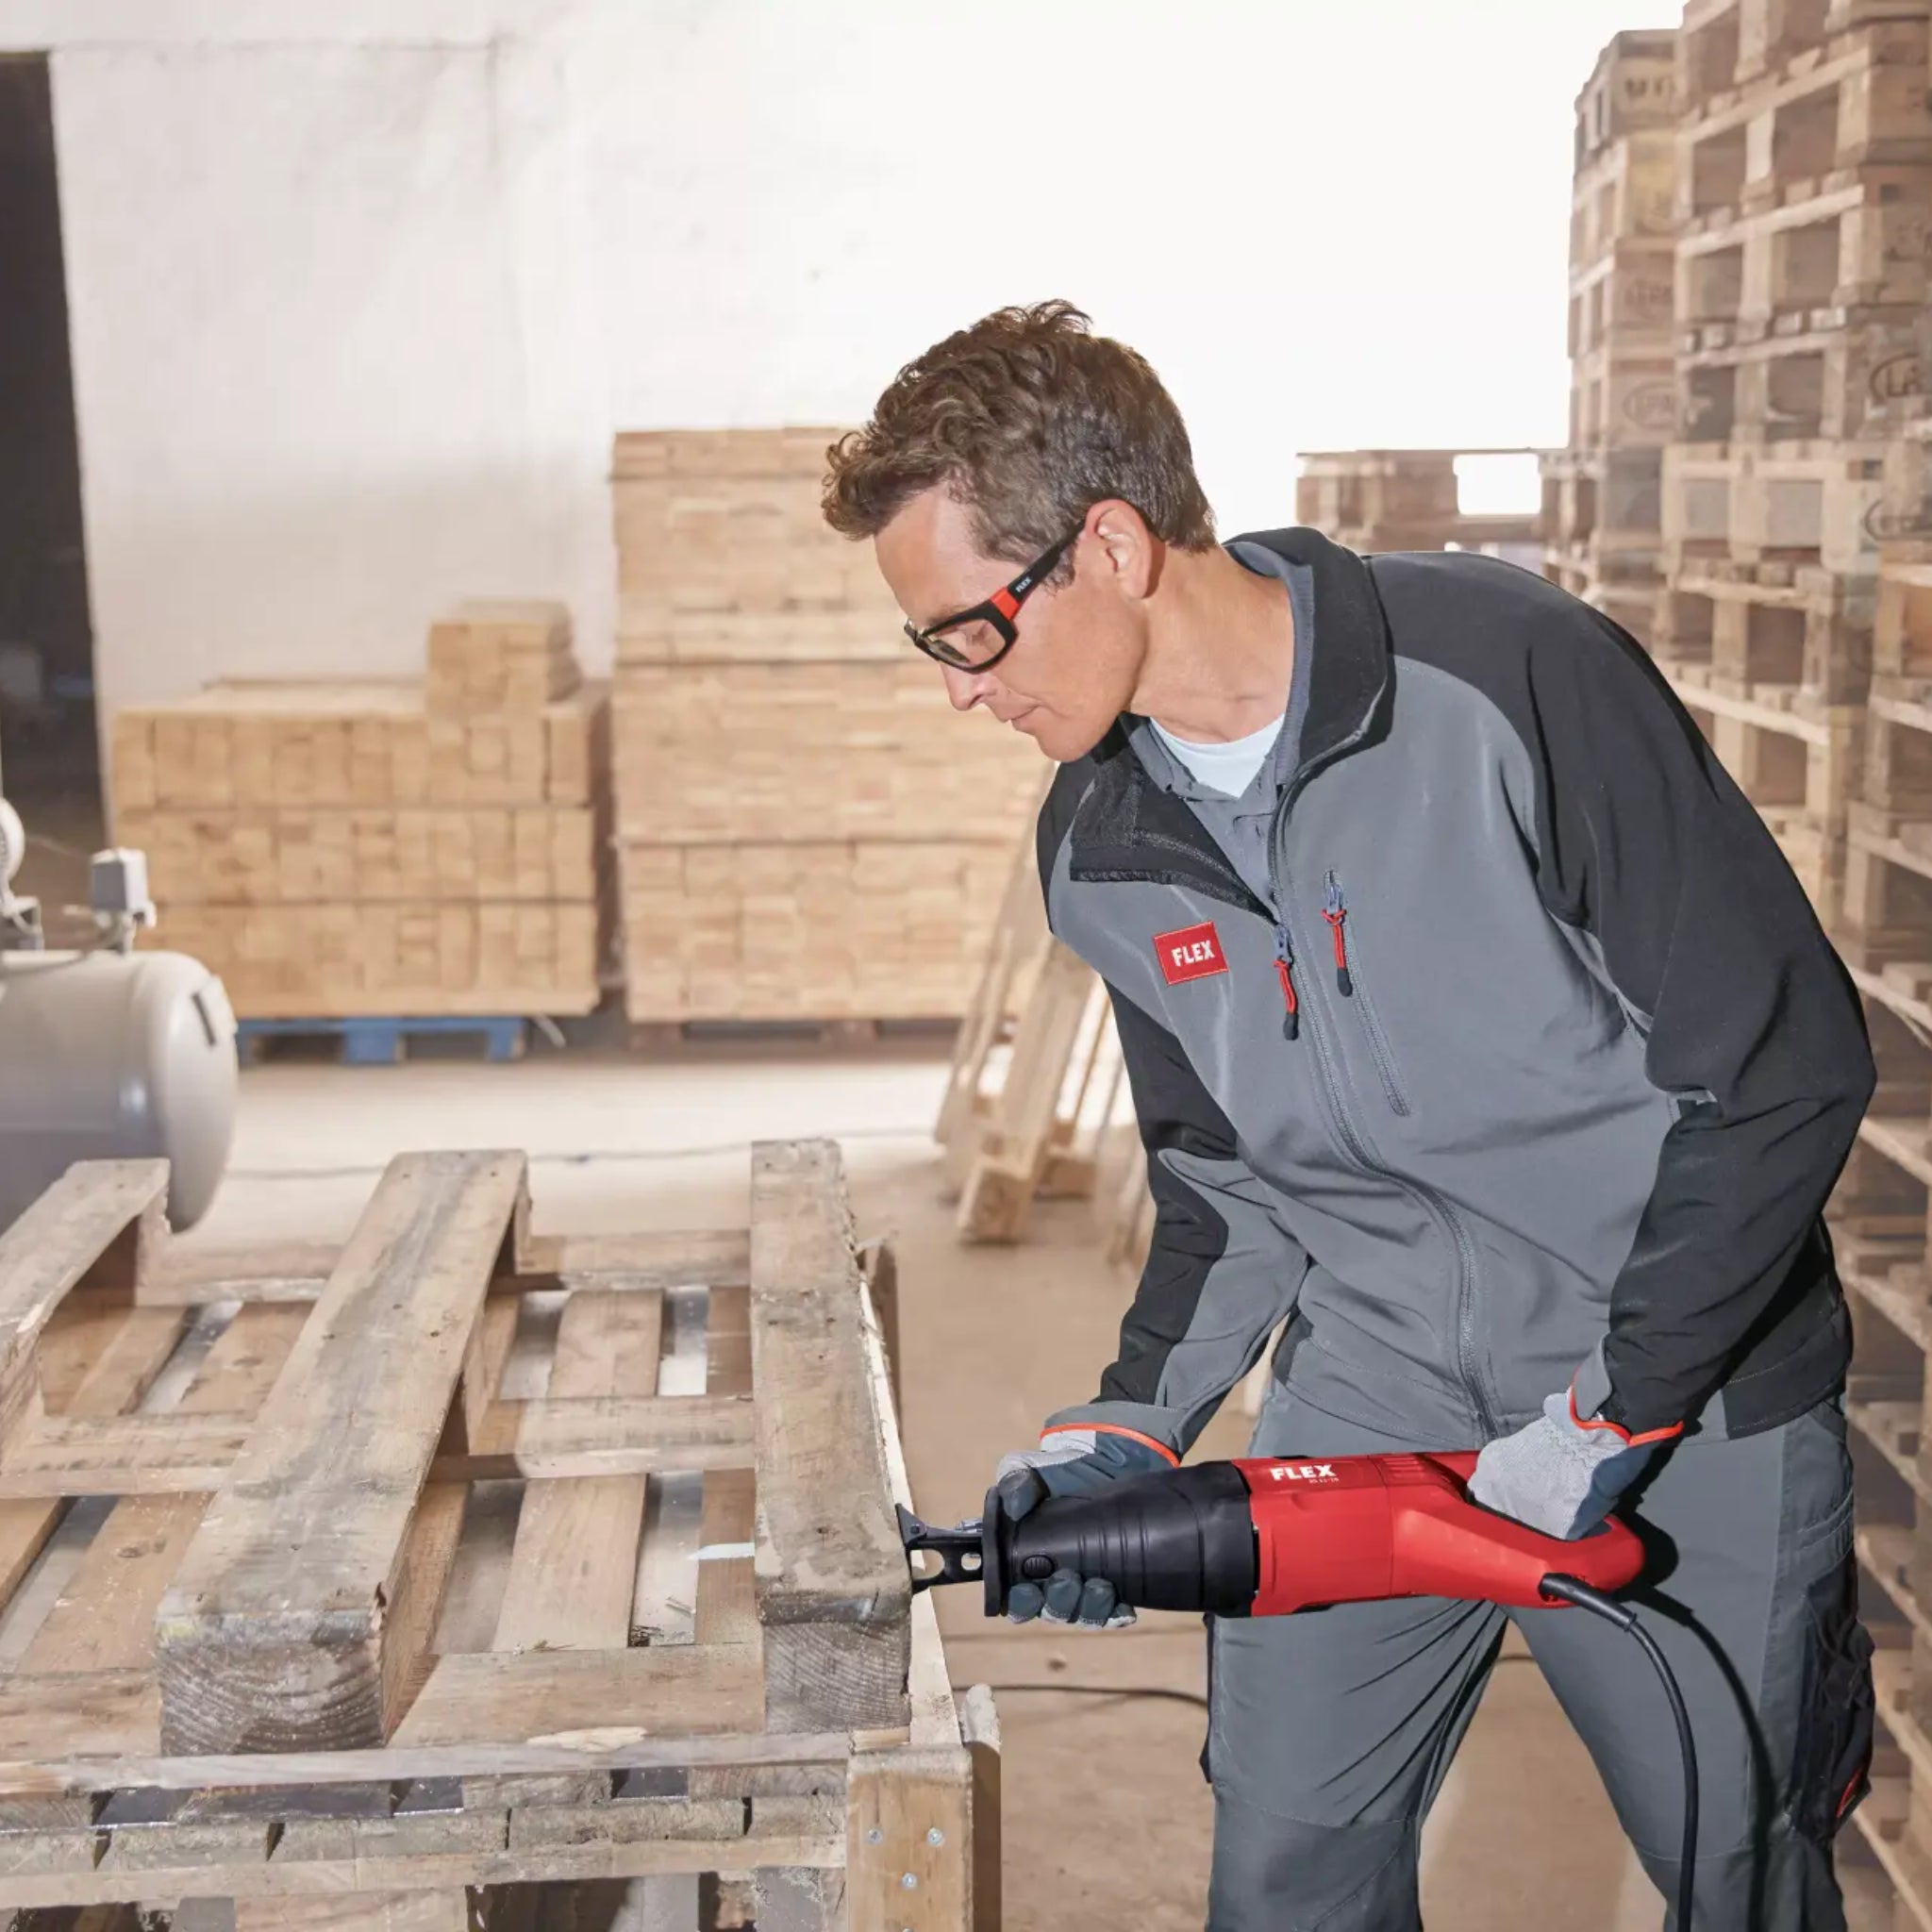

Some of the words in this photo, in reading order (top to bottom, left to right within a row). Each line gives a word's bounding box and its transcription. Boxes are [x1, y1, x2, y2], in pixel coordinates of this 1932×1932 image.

[1015, 576, 1032, 592] FLEX
[1171, 940, 1215, 967] FLEX
[1270, 1464, 1336, 1480] FLEX
